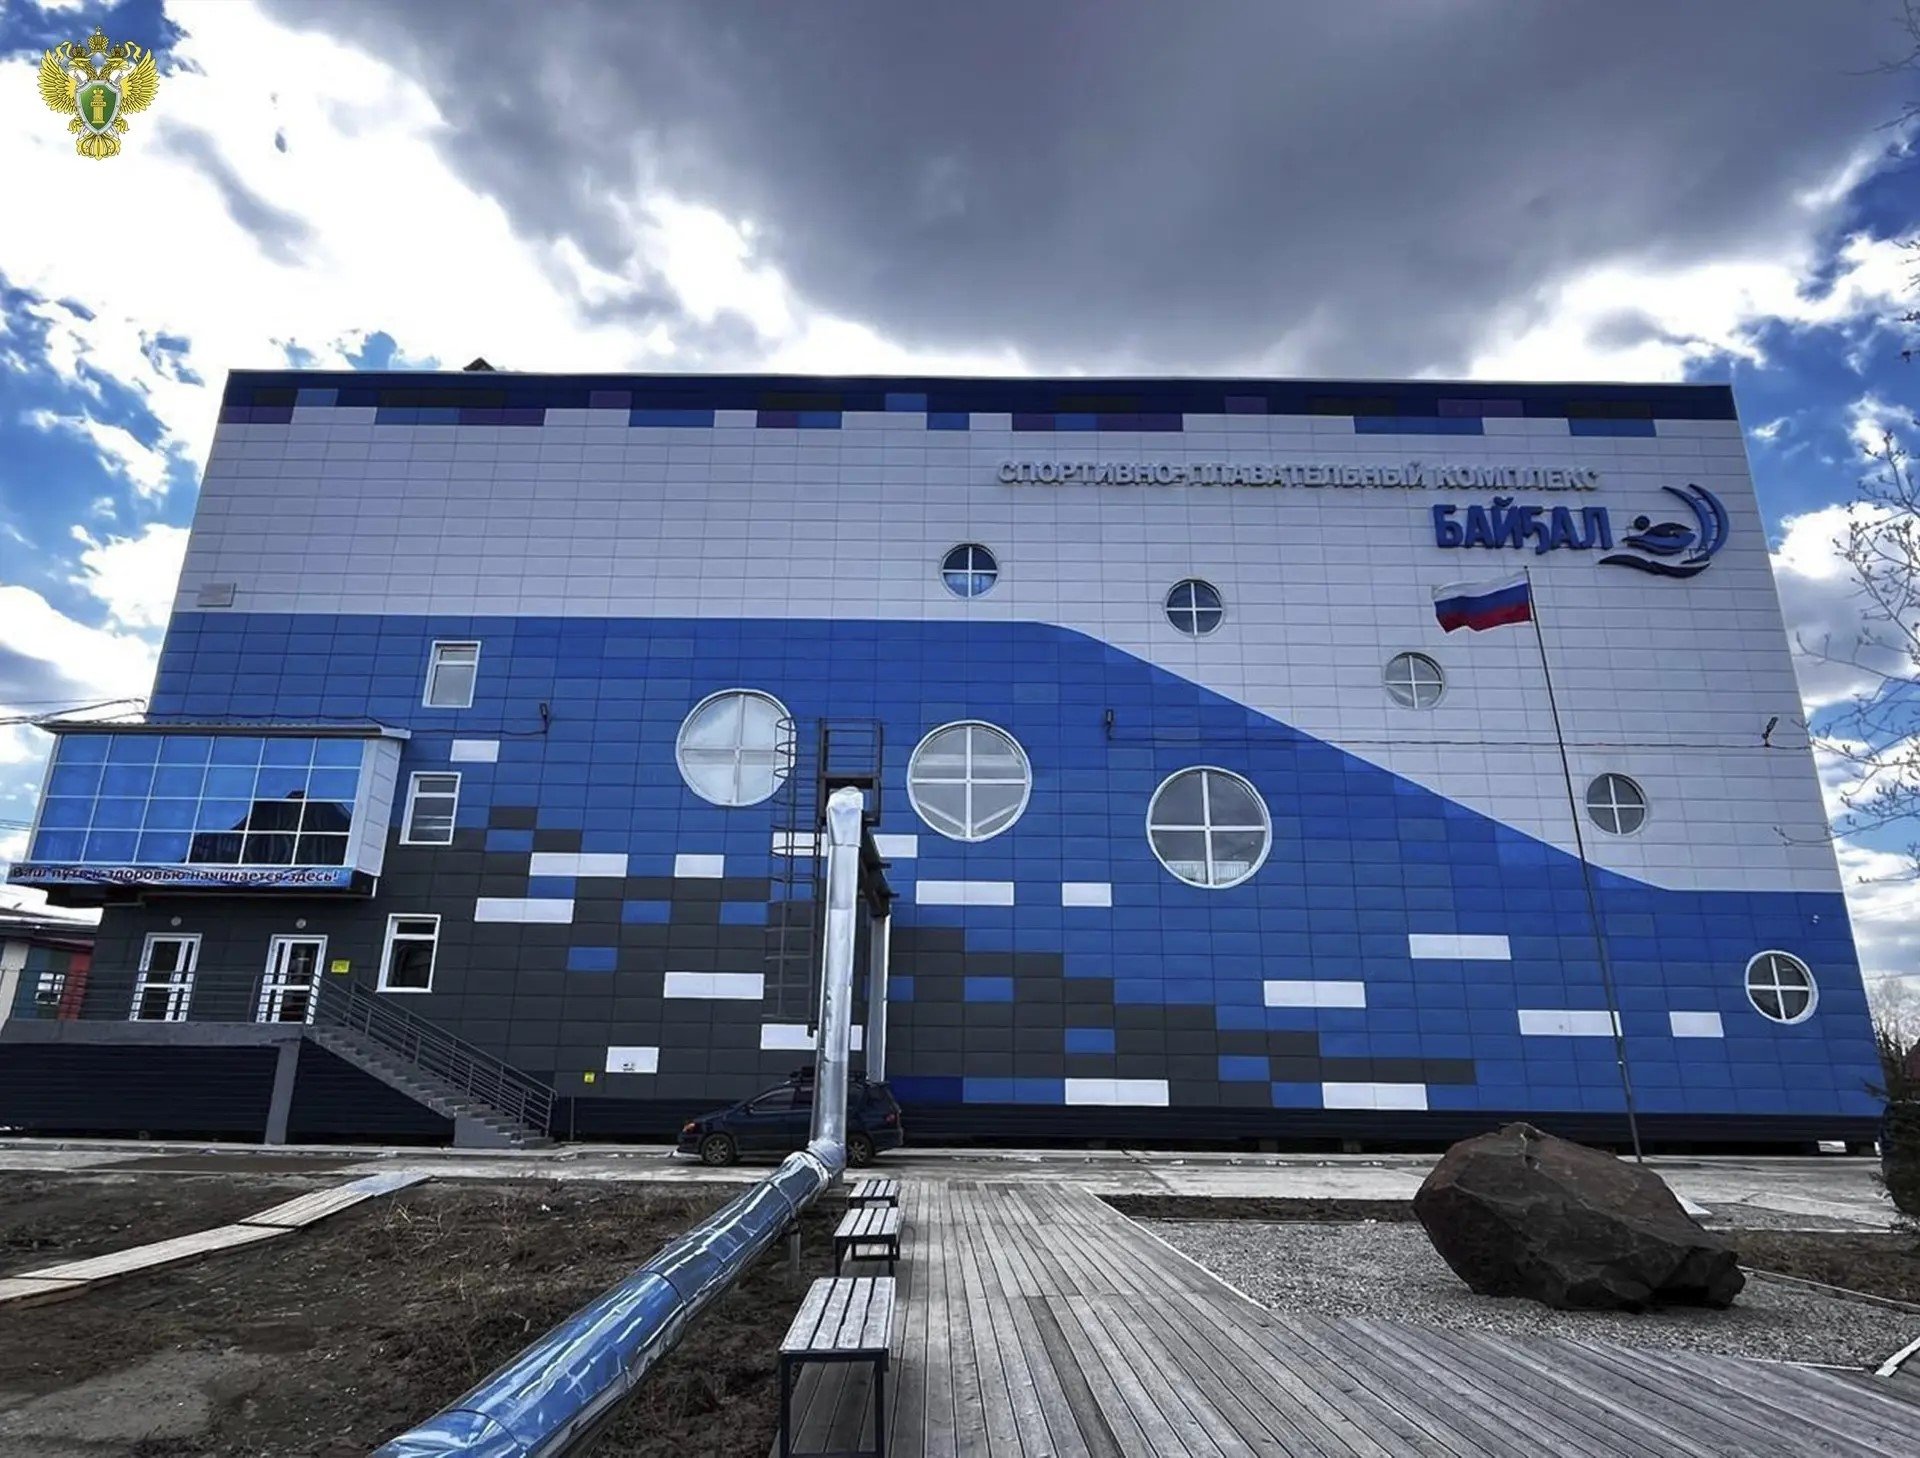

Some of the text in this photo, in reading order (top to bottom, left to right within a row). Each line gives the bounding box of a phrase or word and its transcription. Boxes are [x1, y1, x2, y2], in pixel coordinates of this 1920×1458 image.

[999, 460, 1600, 491] СПОРТИВНО-ПЛАВАТЕЛЬНЫЙ КОМПЛЕКС
[107, 868, 187, 881] здоровью
[191, 870, 284, 882] начинается
[288, 869, 339, 883] здесь!
